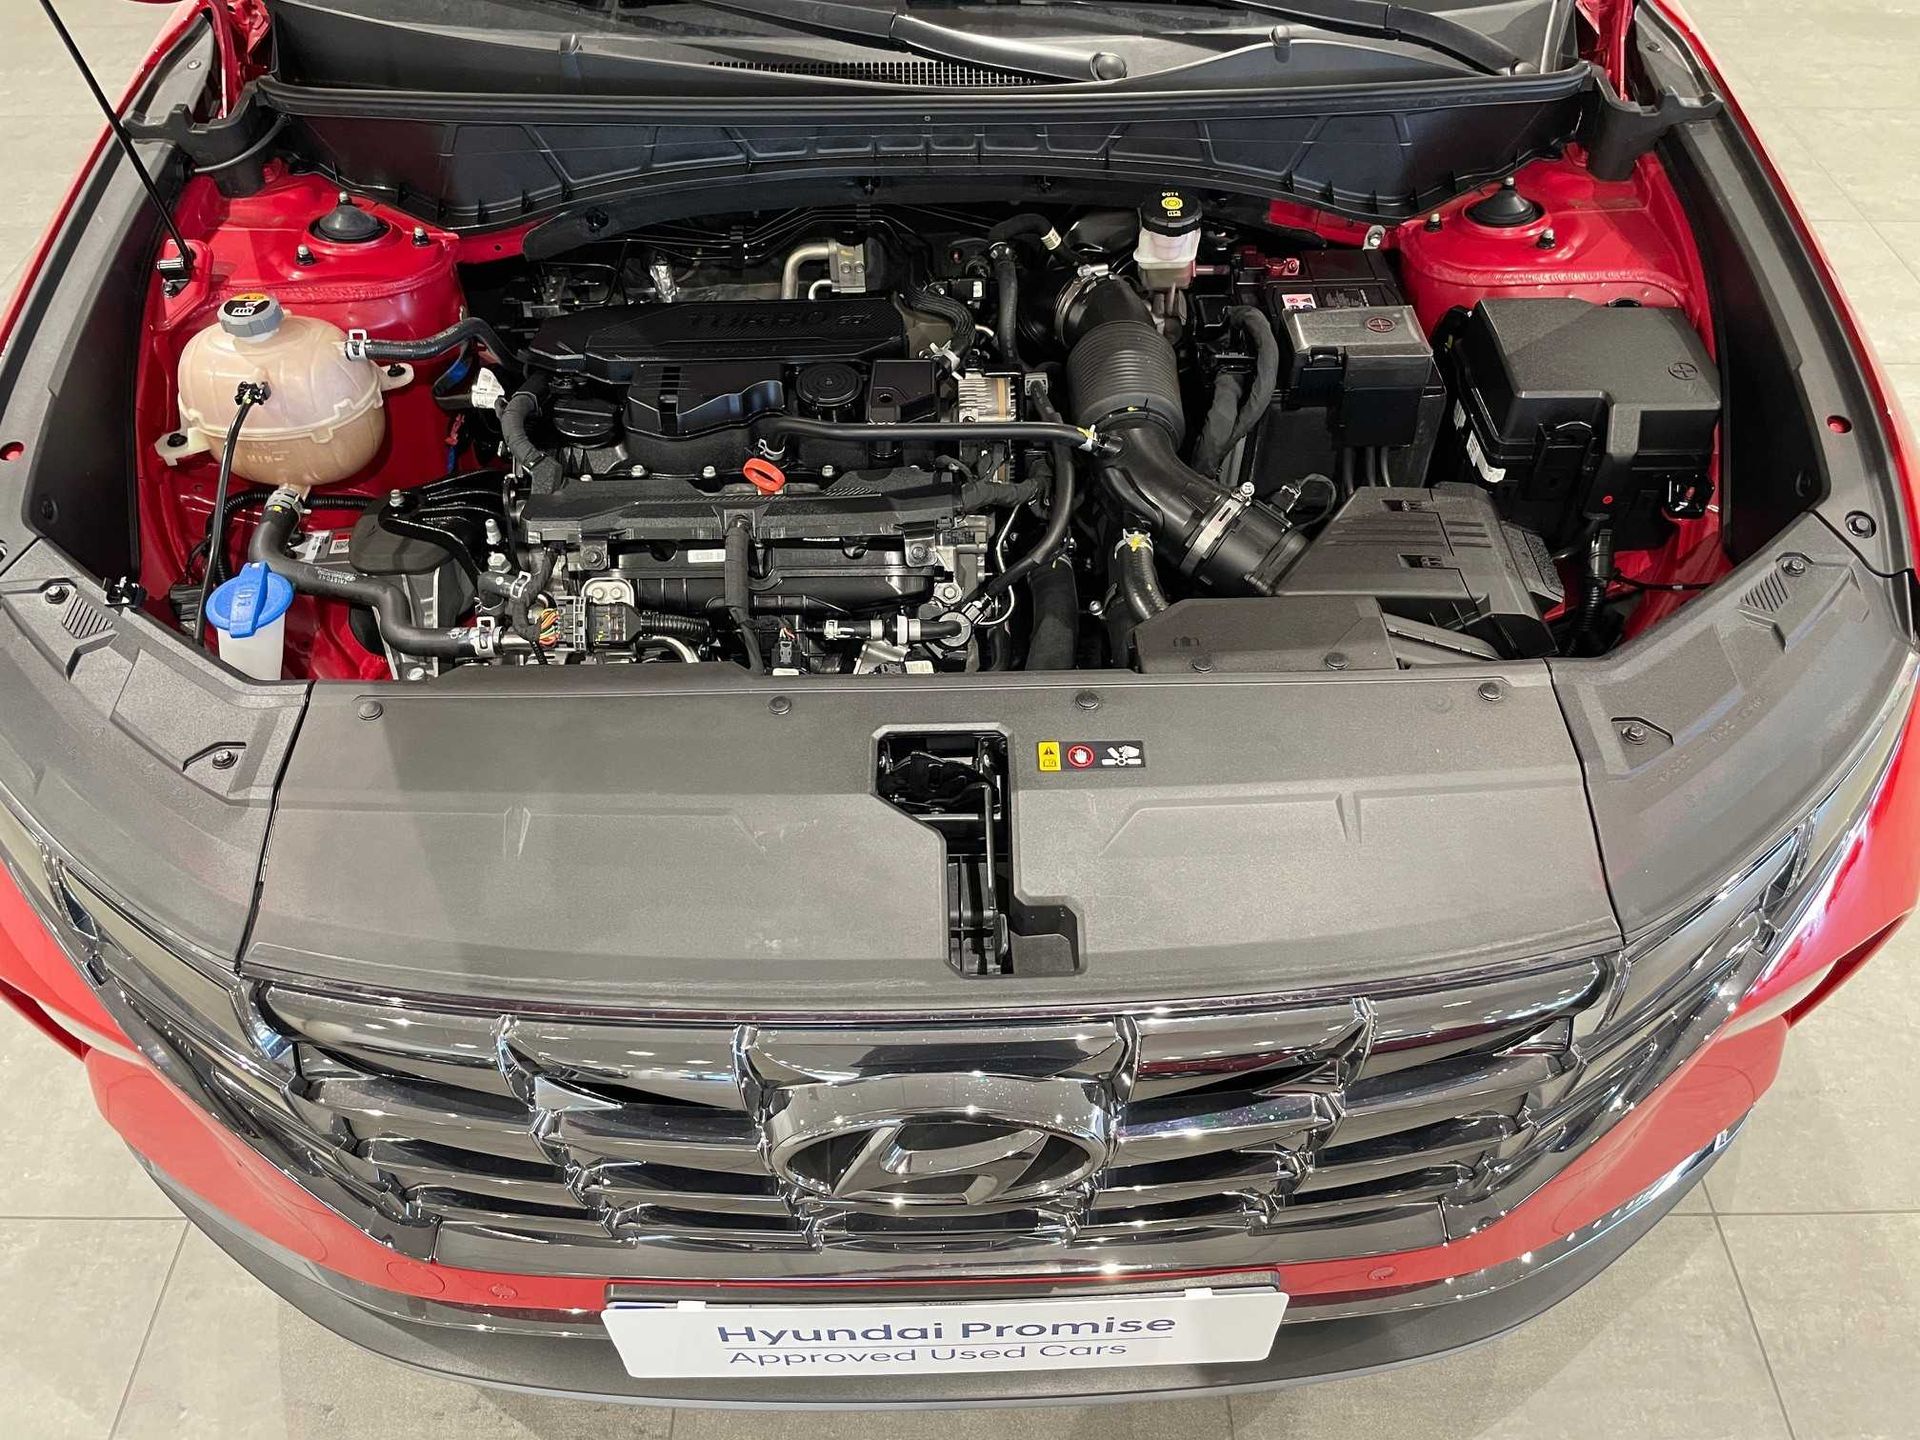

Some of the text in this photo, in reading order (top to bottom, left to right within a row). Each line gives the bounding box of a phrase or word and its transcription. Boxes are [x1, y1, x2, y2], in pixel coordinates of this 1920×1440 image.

[717, 1316, 1176, 1346] Hyundai Promise
[729, 1344, 1127, 1366] Approved Used Cars
